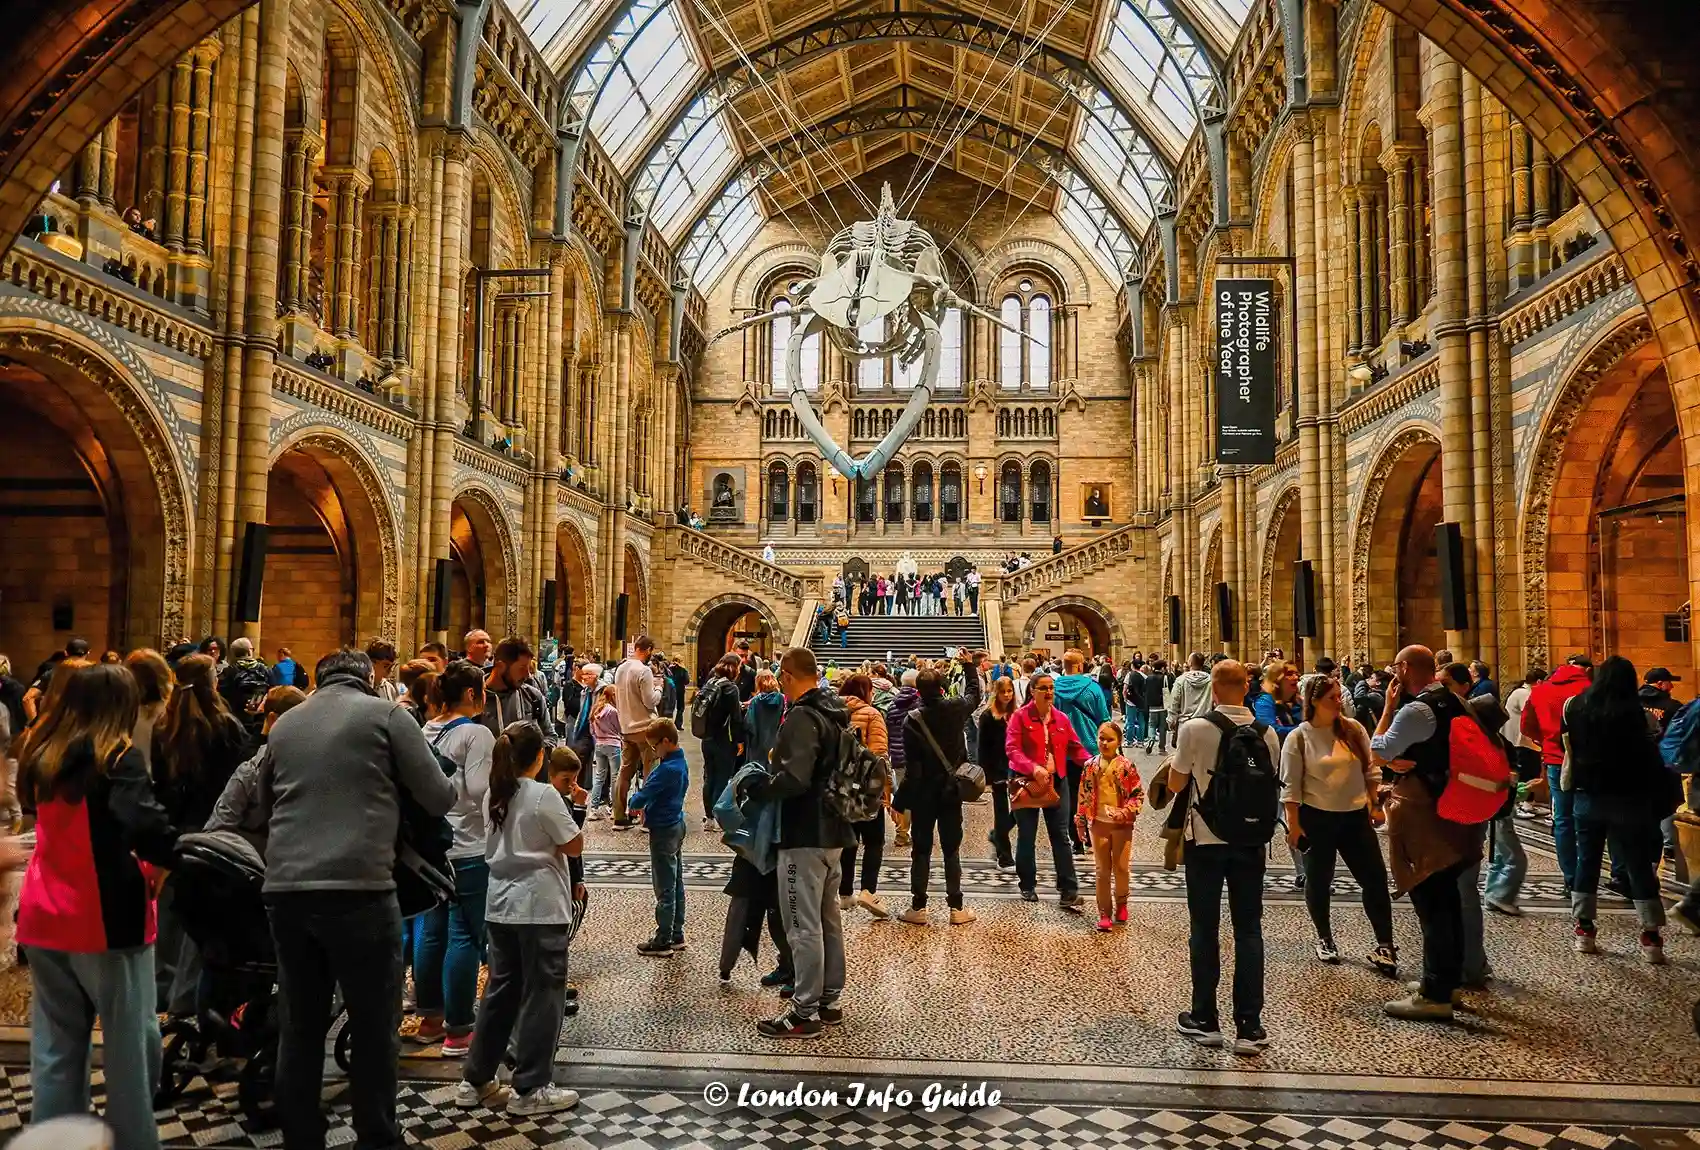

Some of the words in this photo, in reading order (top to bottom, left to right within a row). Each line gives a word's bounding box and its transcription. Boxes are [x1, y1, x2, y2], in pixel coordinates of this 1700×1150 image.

[1220, 291, 1235, 309] of
[1220, 312, 1235, 338] the
[1255, 291, 1271, 351] Wildlife
[1220, 340, 1236, 378] Year
[1236, 291, 1254, 404] Photographer
